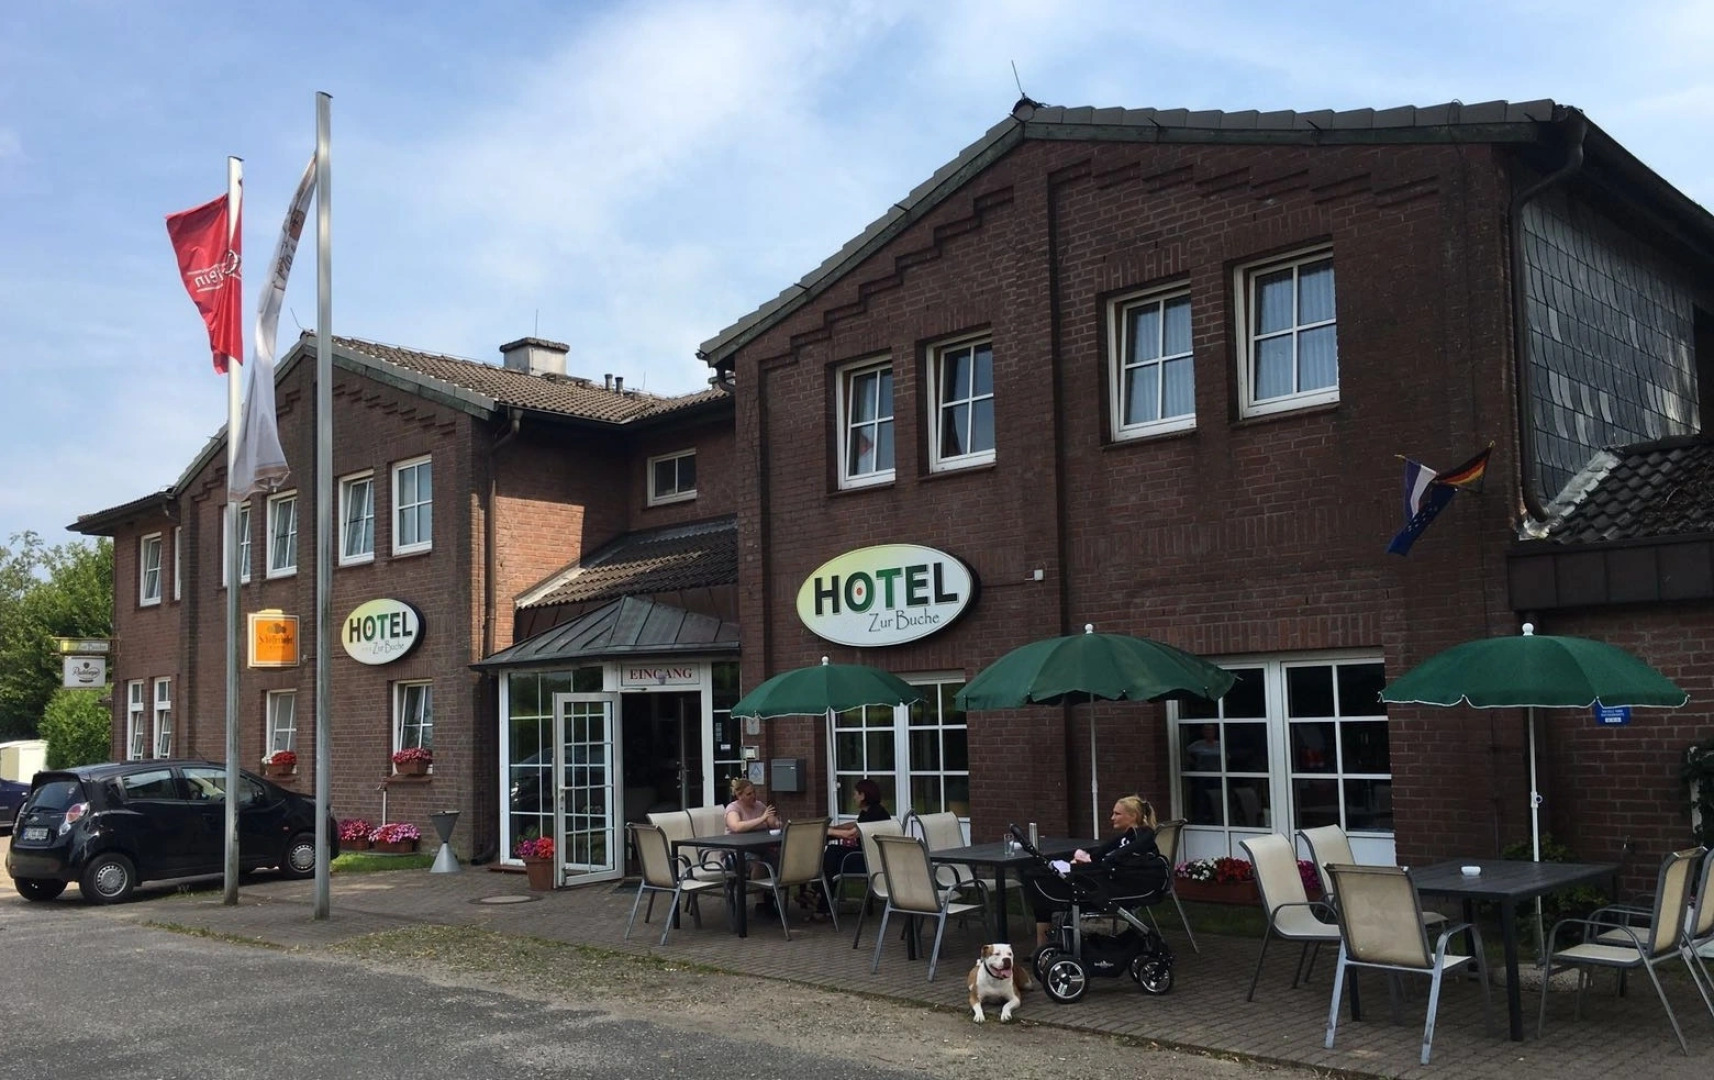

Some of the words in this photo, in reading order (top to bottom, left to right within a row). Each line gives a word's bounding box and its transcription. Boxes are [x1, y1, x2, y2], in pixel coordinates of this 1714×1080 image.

[814, 562, 959, 616] HOTEL
[349, 611, 413, 643] HOTEL
[868, 612, 894, 632] Zur
[896, 608, 940, 630] Buche
[630, 667, 692, 680] EINGANG
